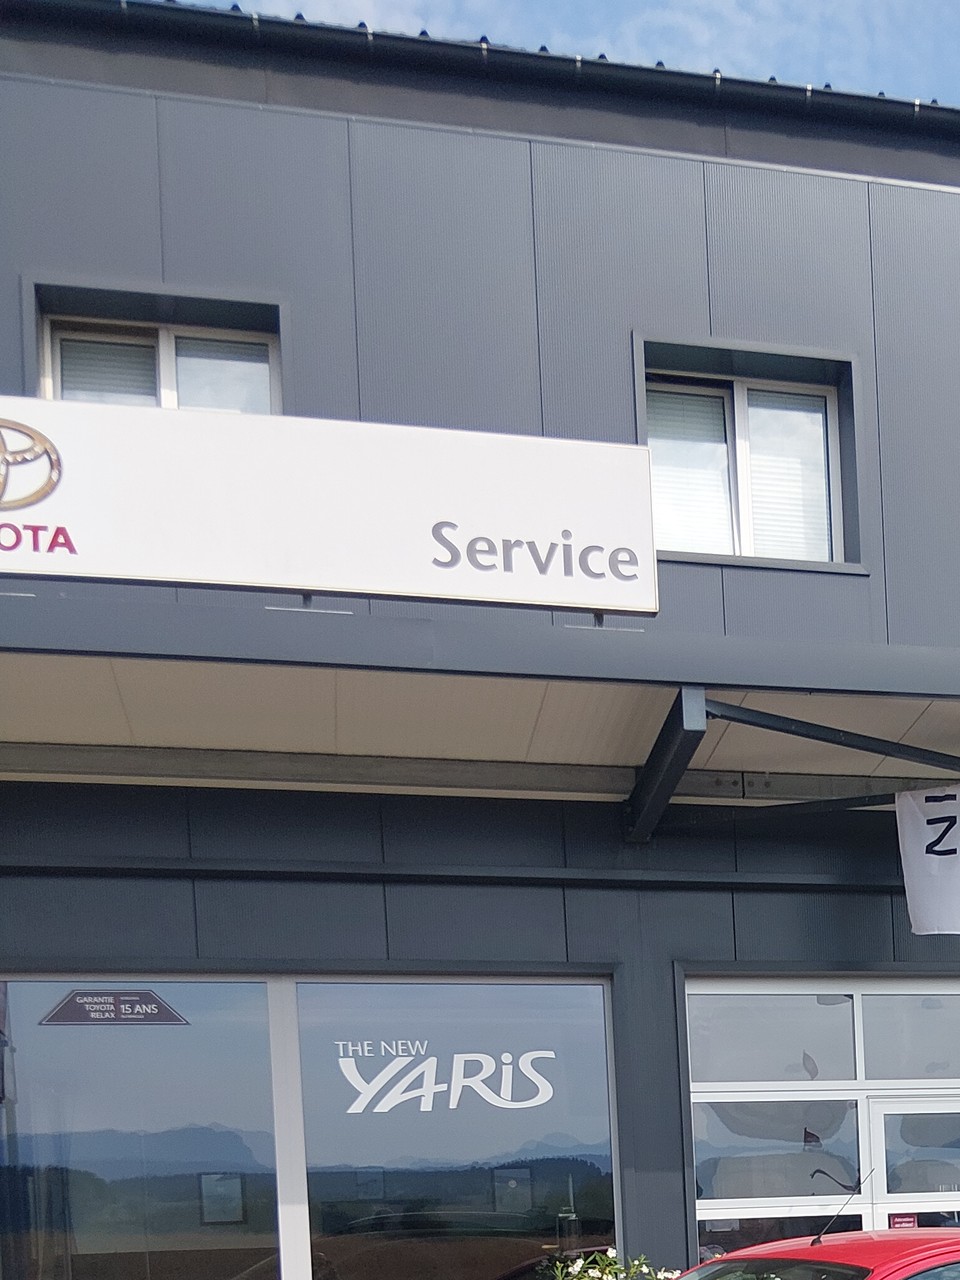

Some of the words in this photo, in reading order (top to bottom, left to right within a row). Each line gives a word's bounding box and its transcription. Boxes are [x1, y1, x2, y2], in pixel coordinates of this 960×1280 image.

[430, 520, 640, 582] Service
[76, 996, 115, 1004] GARANTIE
[120, 1004, 132, 1014] 15
[134, 1004, 158, 1014] ANS
[334, 1041, 375, 1057] THE
[380, 1039, 428, 1056] NEW
